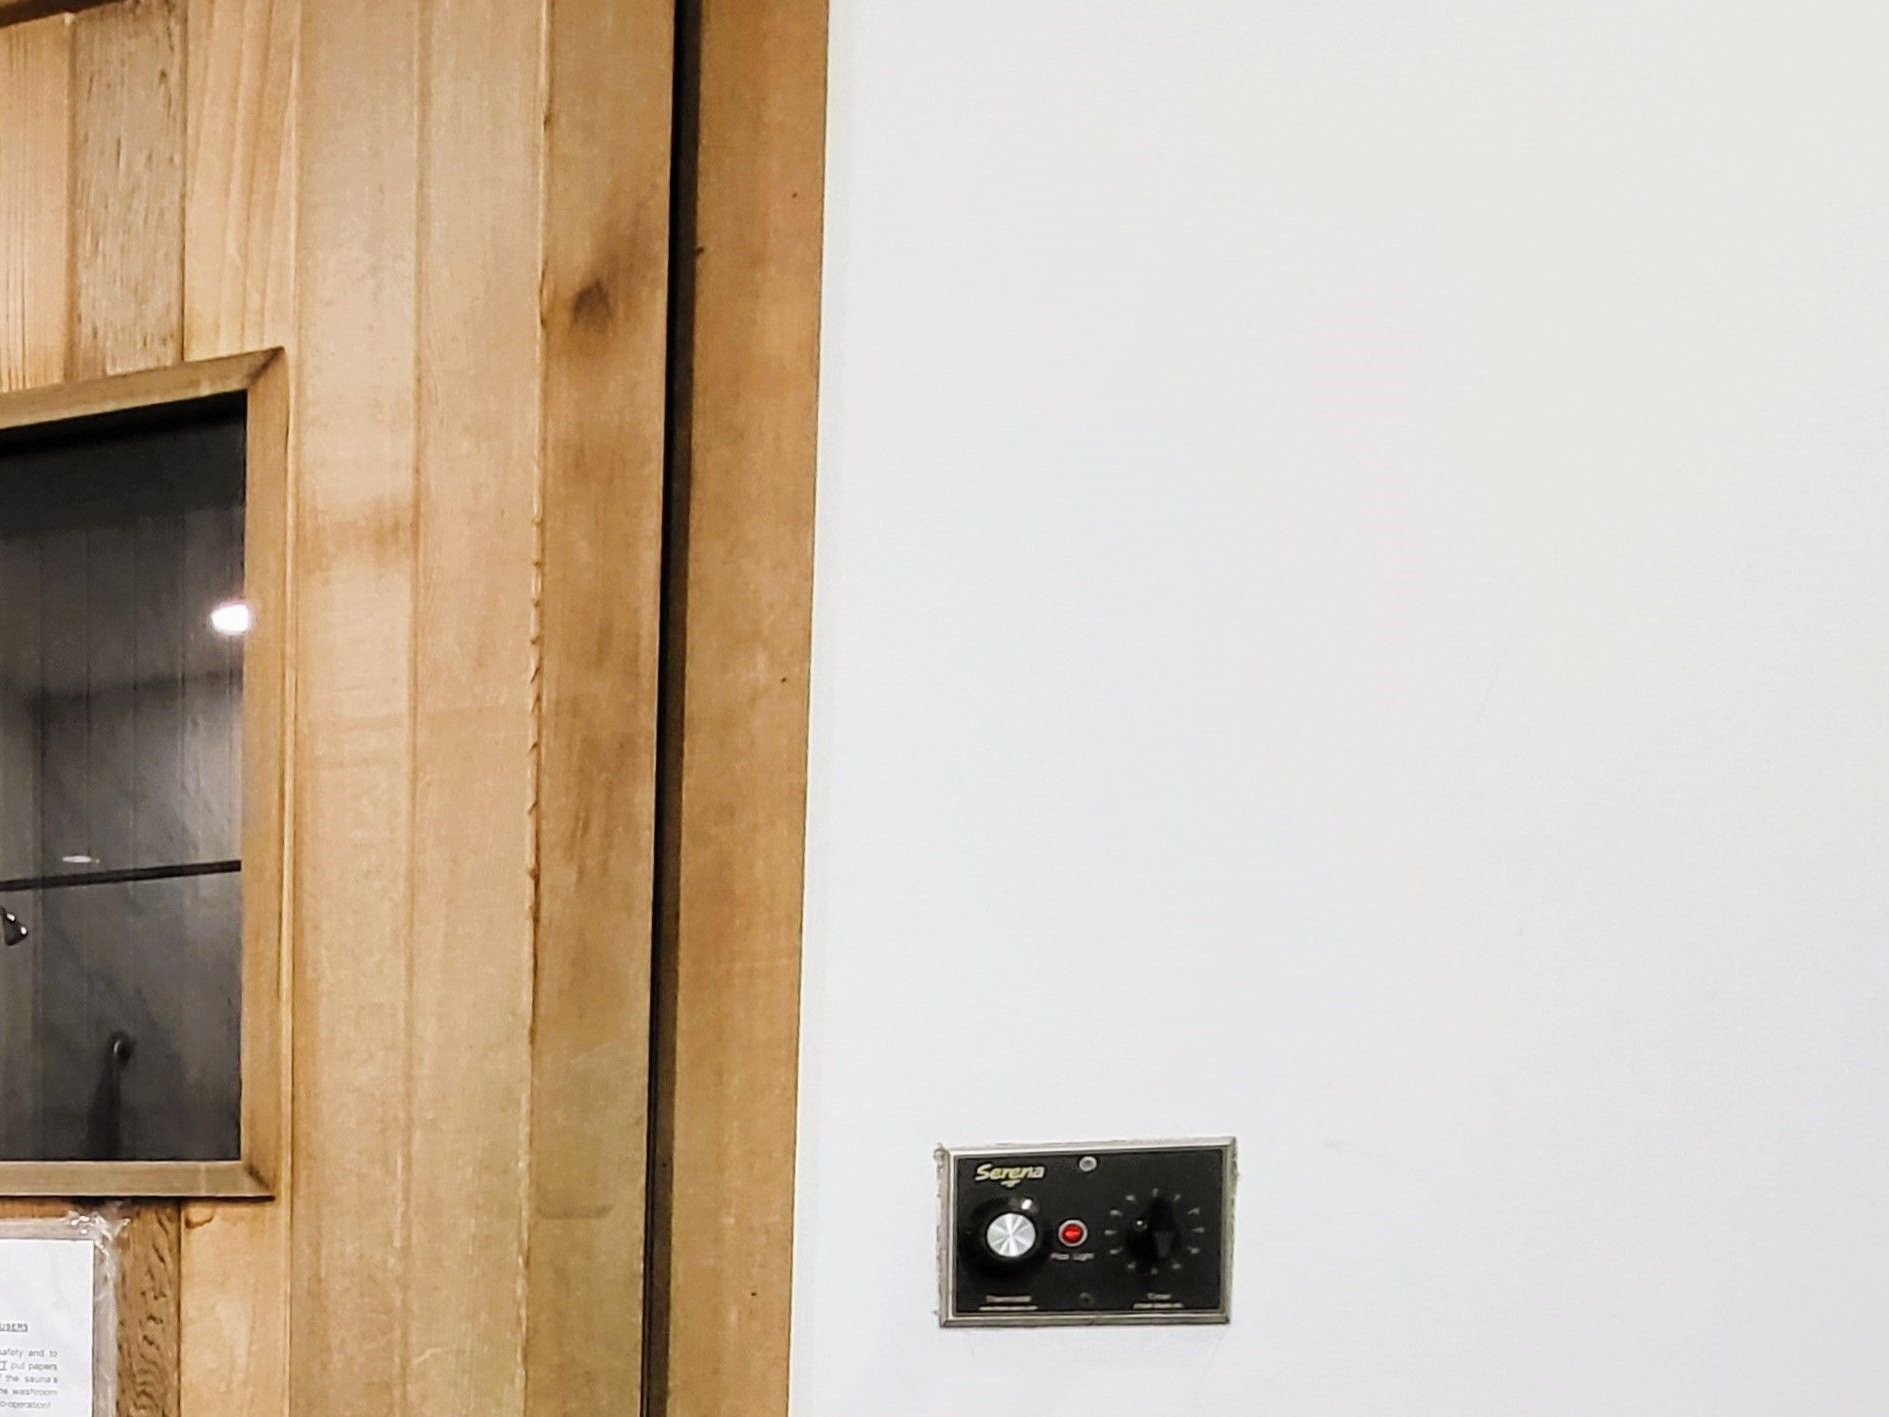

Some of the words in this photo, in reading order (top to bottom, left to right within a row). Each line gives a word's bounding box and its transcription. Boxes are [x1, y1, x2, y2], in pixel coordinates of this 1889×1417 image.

[974, 1163, 1045, 1182] Serena
[0, 1323, 28, 1333] USERS
[28, 1349, 45, 1357] and
